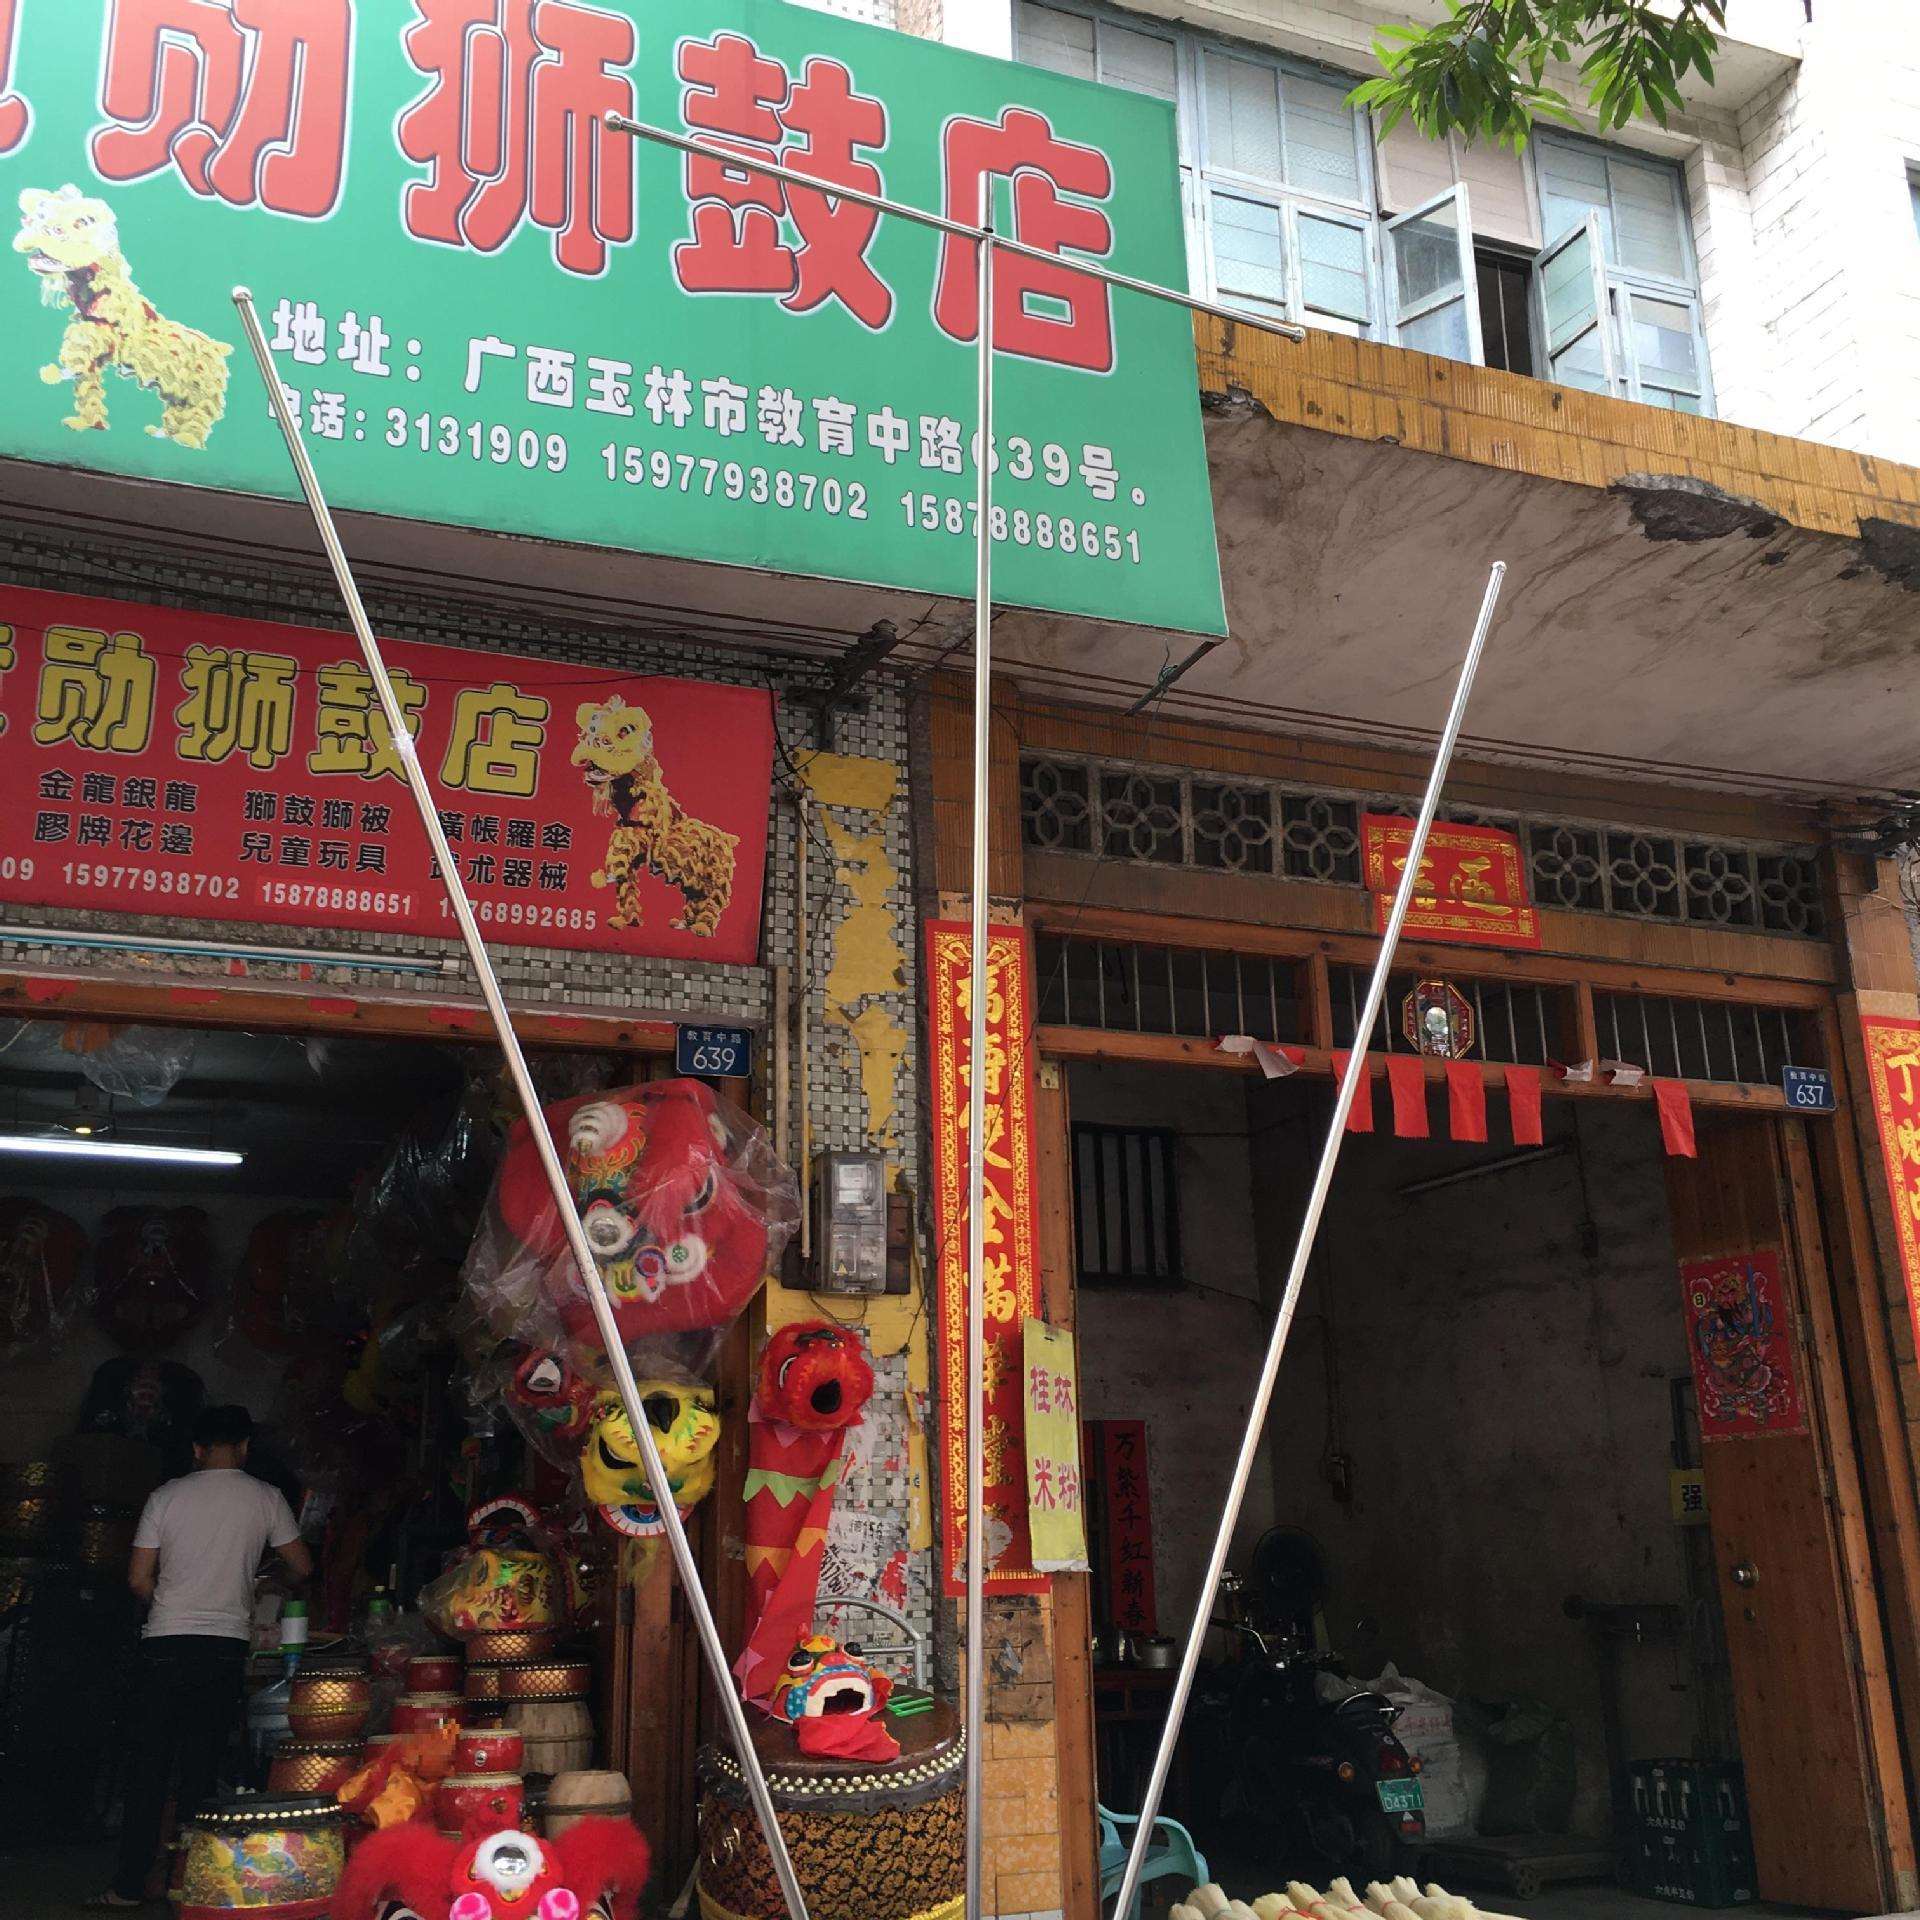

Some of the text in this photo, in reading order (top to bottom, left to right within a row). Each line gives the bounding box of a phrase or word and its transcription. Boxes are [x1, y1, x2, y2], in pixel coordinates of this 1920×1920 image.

[0, 0, 1116, 374] 勋狮鼓店
[600, 441, 869, 521] 15977938702
[0, 622, 549, 798] 勋狮鼓店
[38, 767, 199, 814] 金龍銀龍
[243, 788, 392, 835] 獅鼓獅被
[33, 810, 194, 856] 膠牌花邊
[238, 831, 386, 875] 兒童玩具
[61, 862, 240, 899] 15977938702
[261, 881, 412, 916] 15878888651
[439, 897, 597, 931] 1768992685
[693, 1046, 736, 1072] 639
[1796, 1084, 1824, 1105] 637
